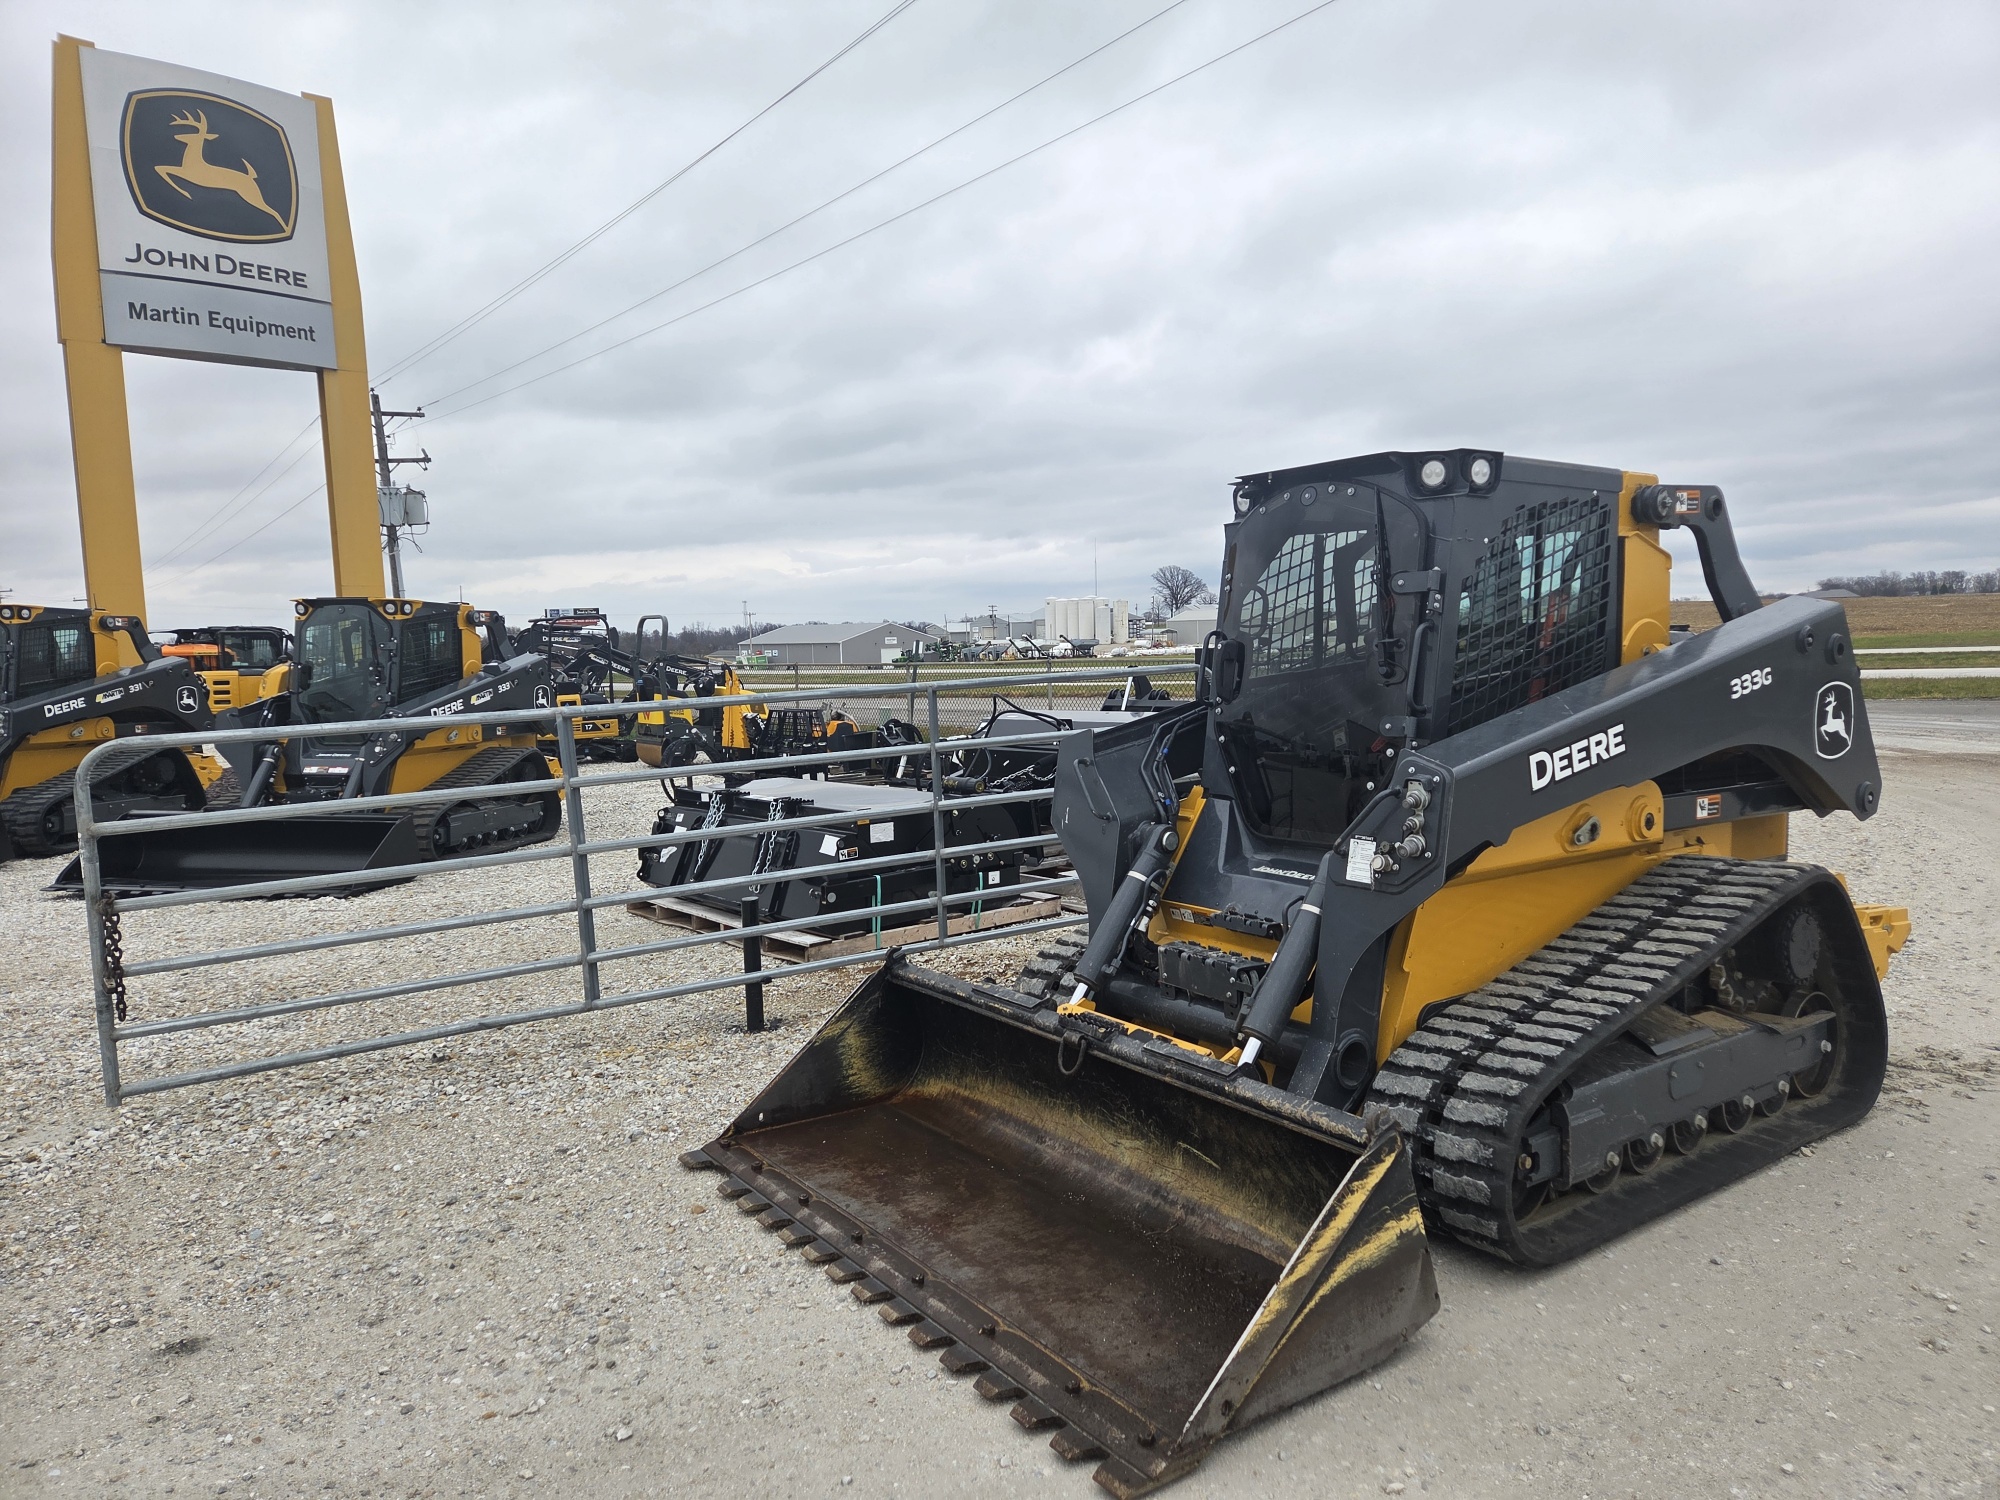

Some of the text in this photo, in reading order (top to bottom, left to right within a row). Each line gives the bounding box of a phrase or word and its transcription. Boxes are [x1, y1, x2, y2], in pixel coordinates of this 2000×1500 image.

[125, 243, 308, 289] JOHN DEERE
[128, 302, 316, 342] Martin Equipment
[665, 665, 688, 675] DEERE
[1730, 667, 1772, 700] 333G
[129, 682, 142, 693] 331
[44, 697, 86, 718] DEERE
[430, 699, 465, 717] DEERE
[1528, 723, 1626, 792] DEERE
